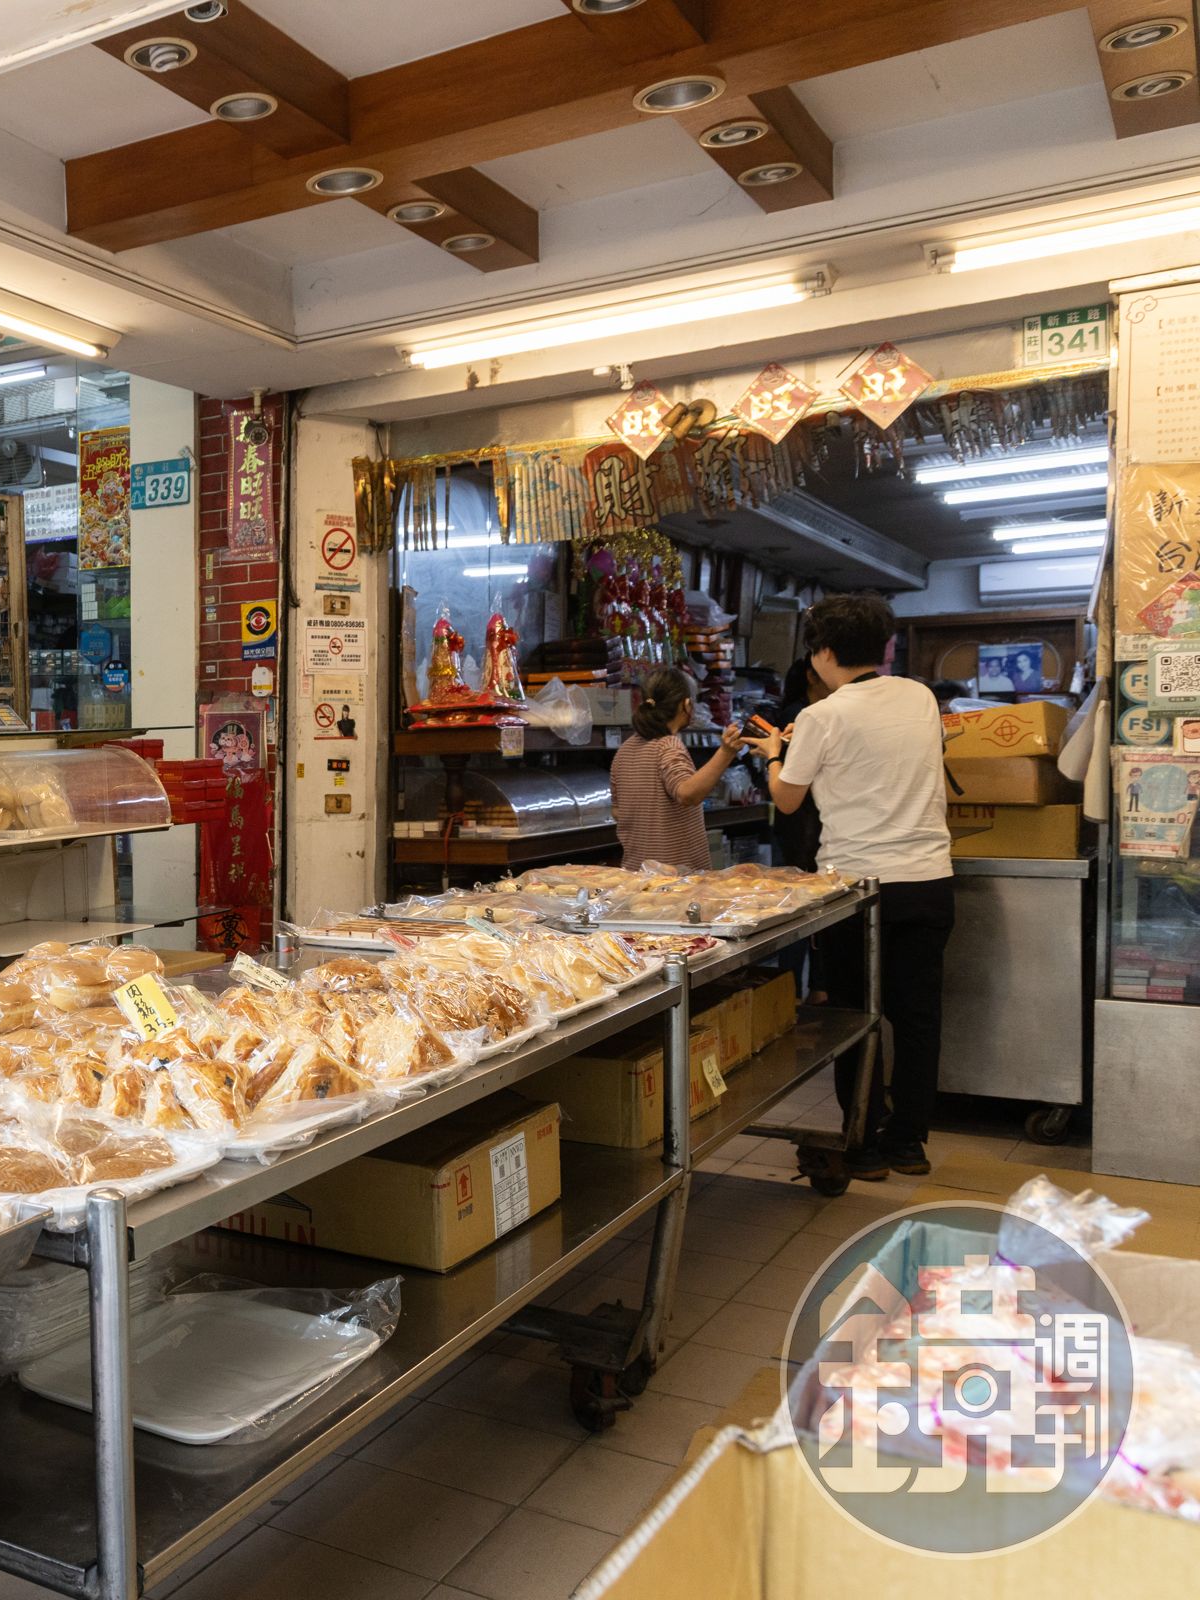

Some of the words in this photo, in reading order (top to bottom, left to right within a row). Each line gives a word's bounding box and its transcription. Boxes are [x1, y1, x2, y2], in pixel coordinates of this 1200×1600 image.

[1047, 308, 1100, 327] 新莊路
[1047, 325, 1099, 357] 341
[861, 365, 908, 402] 旺
[750, 382, 796, 421] 旺
[148, 474, 186, 502] 339
[1128, 717, 1161, 732] FSI
